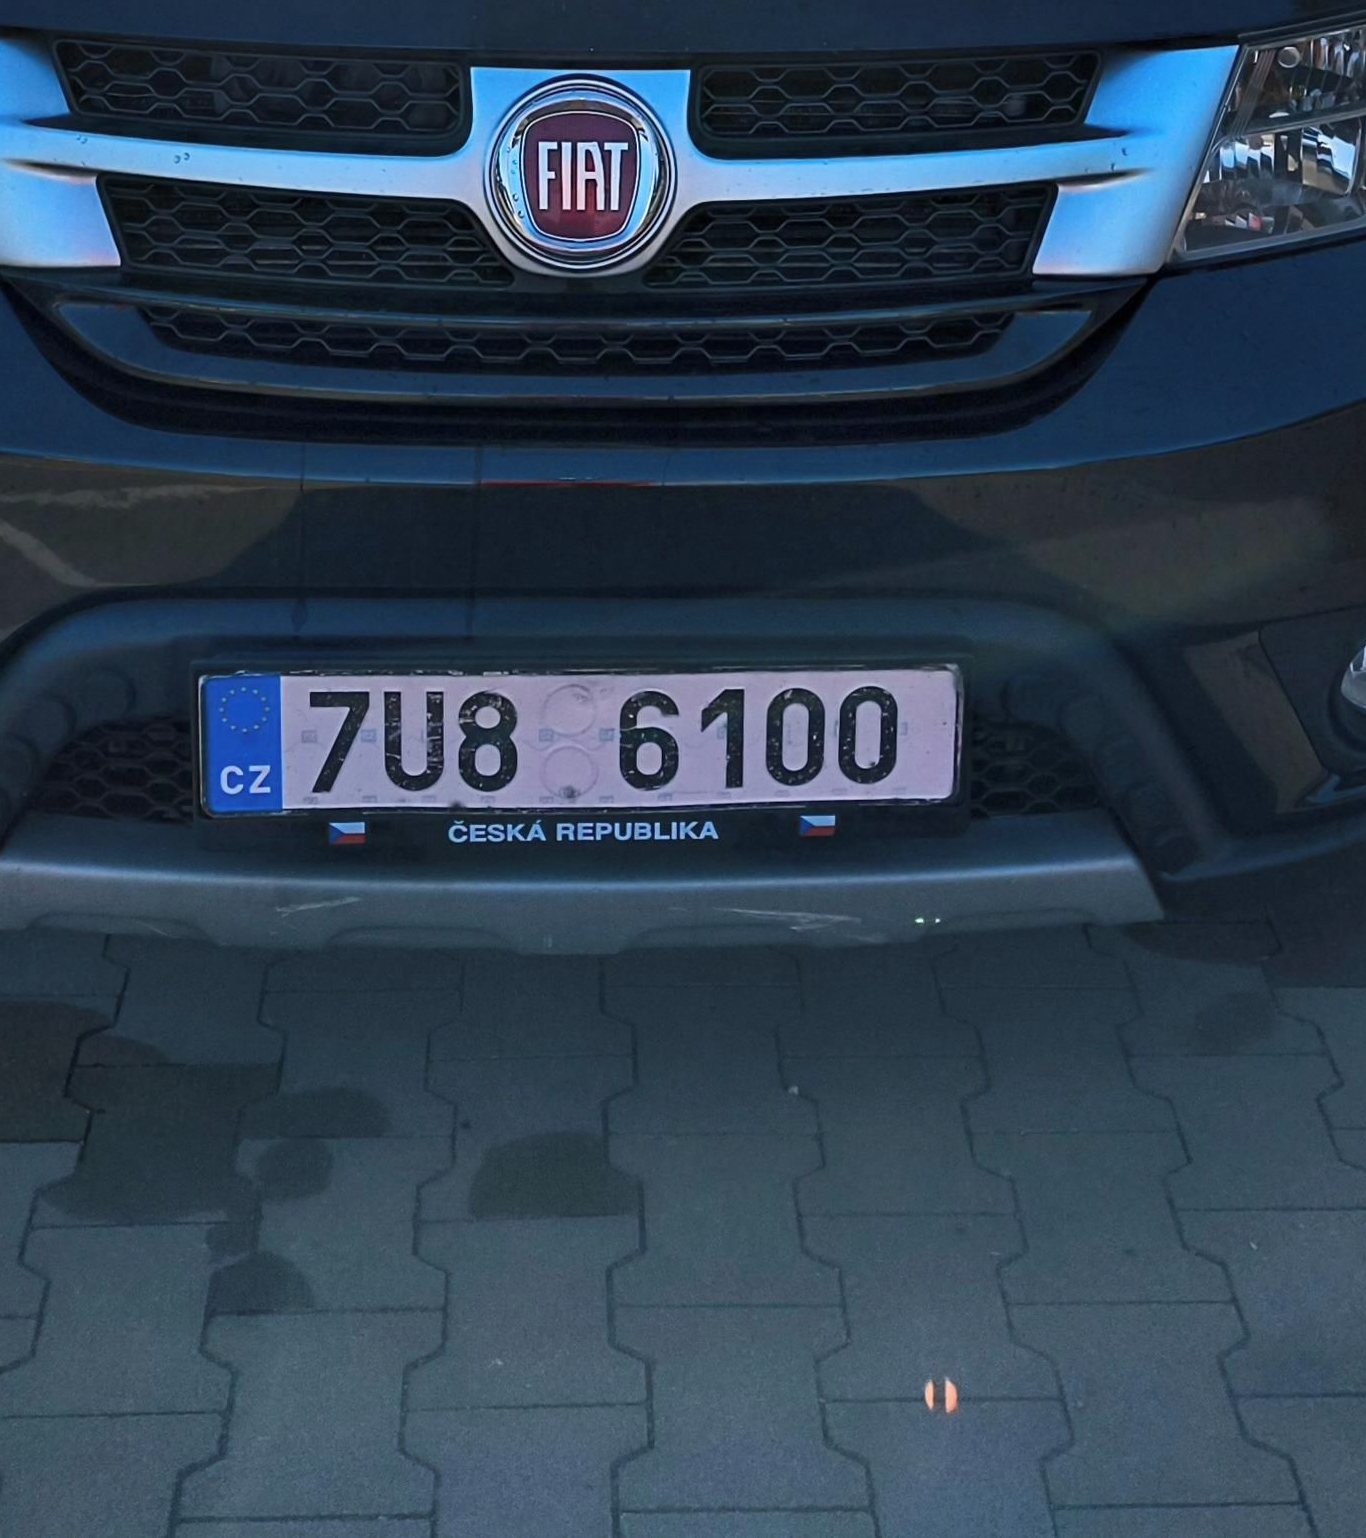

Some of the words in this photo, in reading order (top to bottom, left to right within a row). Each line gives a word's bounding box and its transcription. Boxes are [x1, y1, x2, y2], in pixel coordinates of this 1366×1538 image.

[537, 141, 629, 211] FIAT
[309, 690, 519, 793] 7U8
[619, 685, 899, 792] 6100
[219, 764, 272, 795] CZ
[448, 819, 546, 844] ČESKÁ
[556, 820, 719, 843] REPUBLIKA
